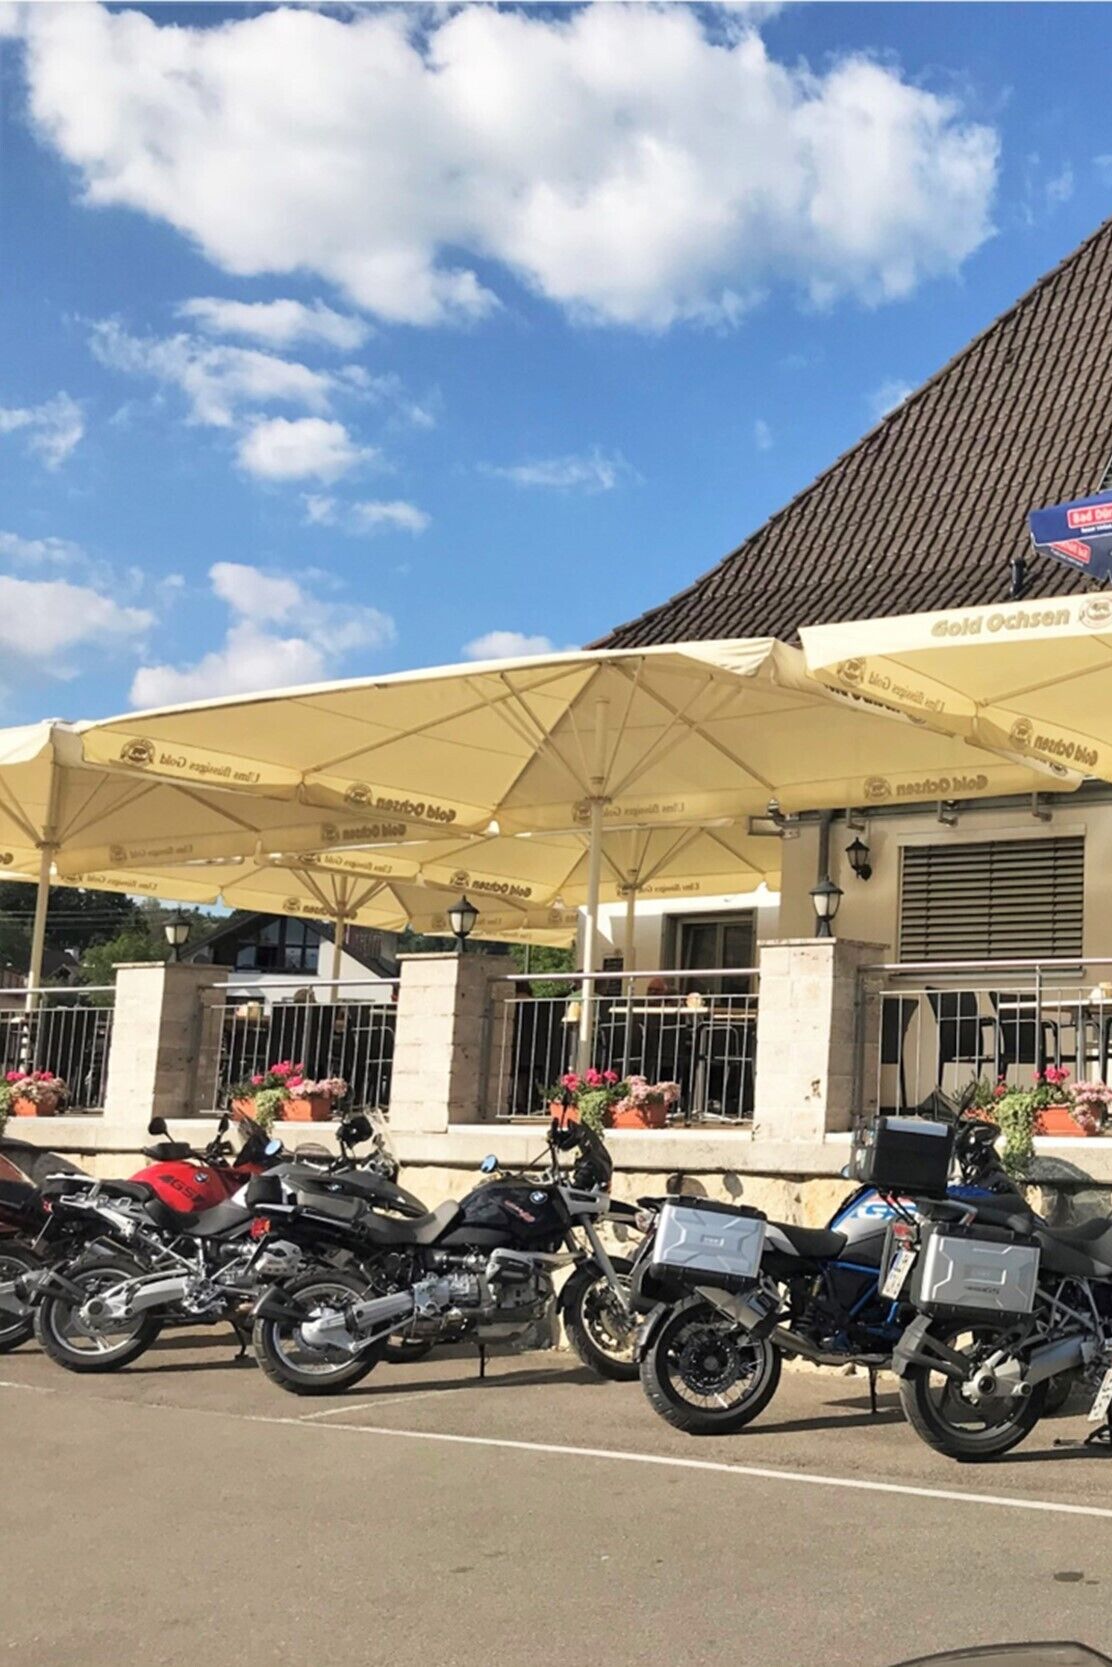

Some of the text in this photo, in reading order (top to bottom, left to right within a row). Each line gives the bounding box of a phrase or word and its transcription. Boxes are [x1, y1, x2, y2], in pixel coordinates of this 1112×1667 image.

[1072, 509, 1092, 524] Bad
[931, 616, 983, 637] Gold
[986, 608, 1071, 633] Ochsen
